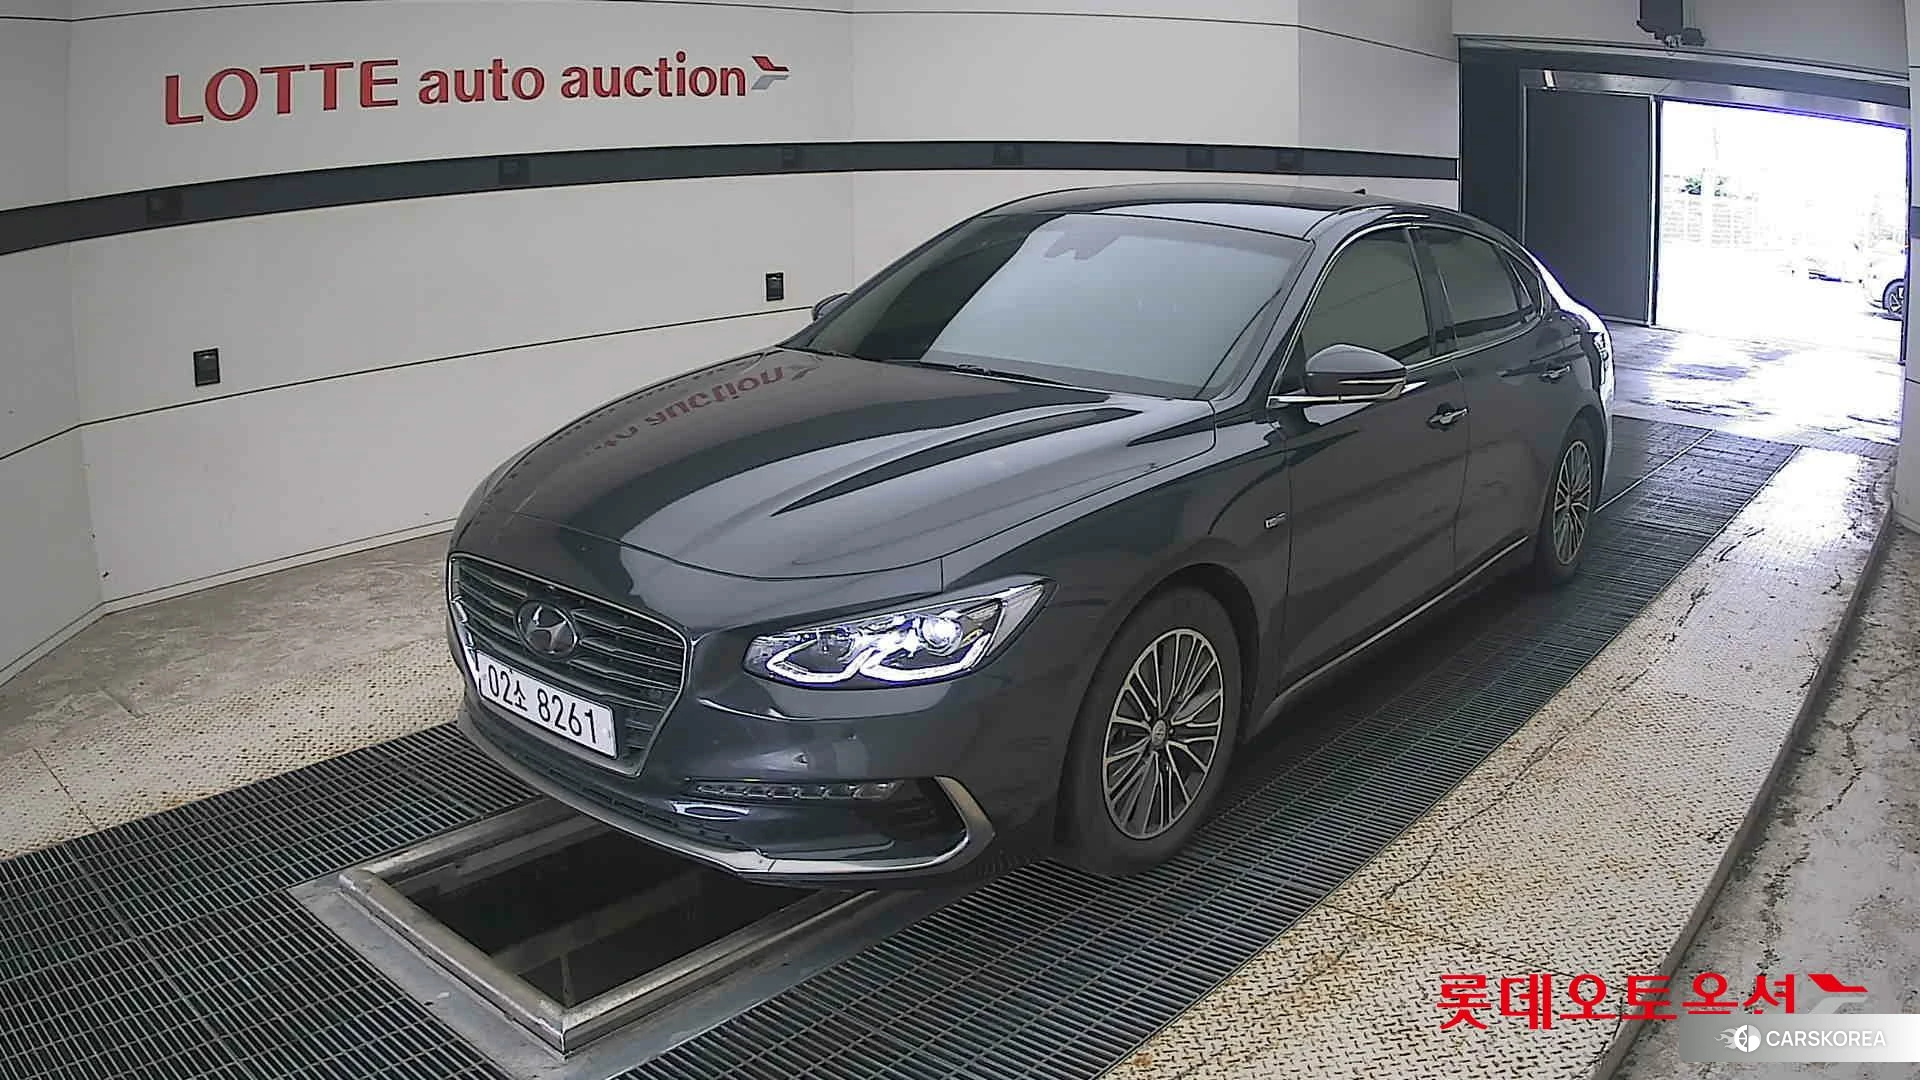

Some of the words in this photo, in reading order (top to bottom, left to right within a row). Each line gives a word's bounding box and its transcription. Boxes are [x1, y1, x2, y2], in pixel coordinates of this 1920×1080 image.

[164, 59, 400, 125] LOTTE
[417, 58, 546, 104] auto
[560, 51, 747, 98] auction
[487, 664, 528, 712] 02소
[536, 687, 597, 744] 8261
